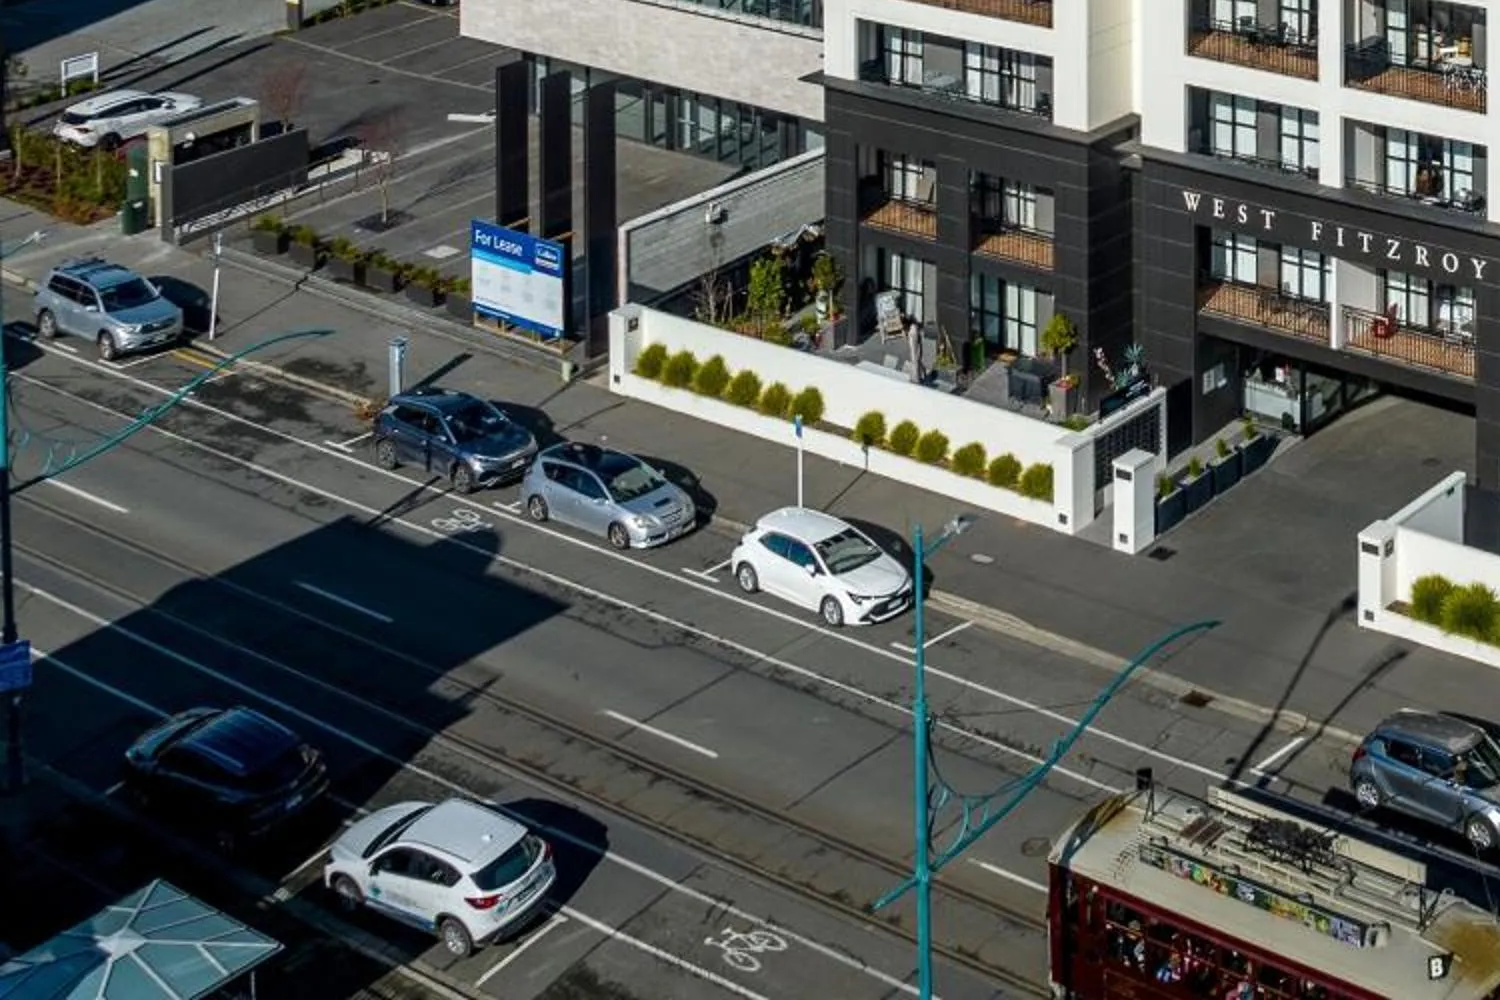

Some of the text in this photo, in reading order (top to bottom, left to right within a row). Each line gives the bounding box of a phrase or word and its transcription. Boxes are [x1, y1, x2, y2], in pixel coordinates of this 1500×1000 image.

[475, 229, 491, 246] For
[493, 235, 523, 257] Lease
[1183, 191, 1487, 280] WEST FITZROY
[1431, 957, 1444, 977] B
